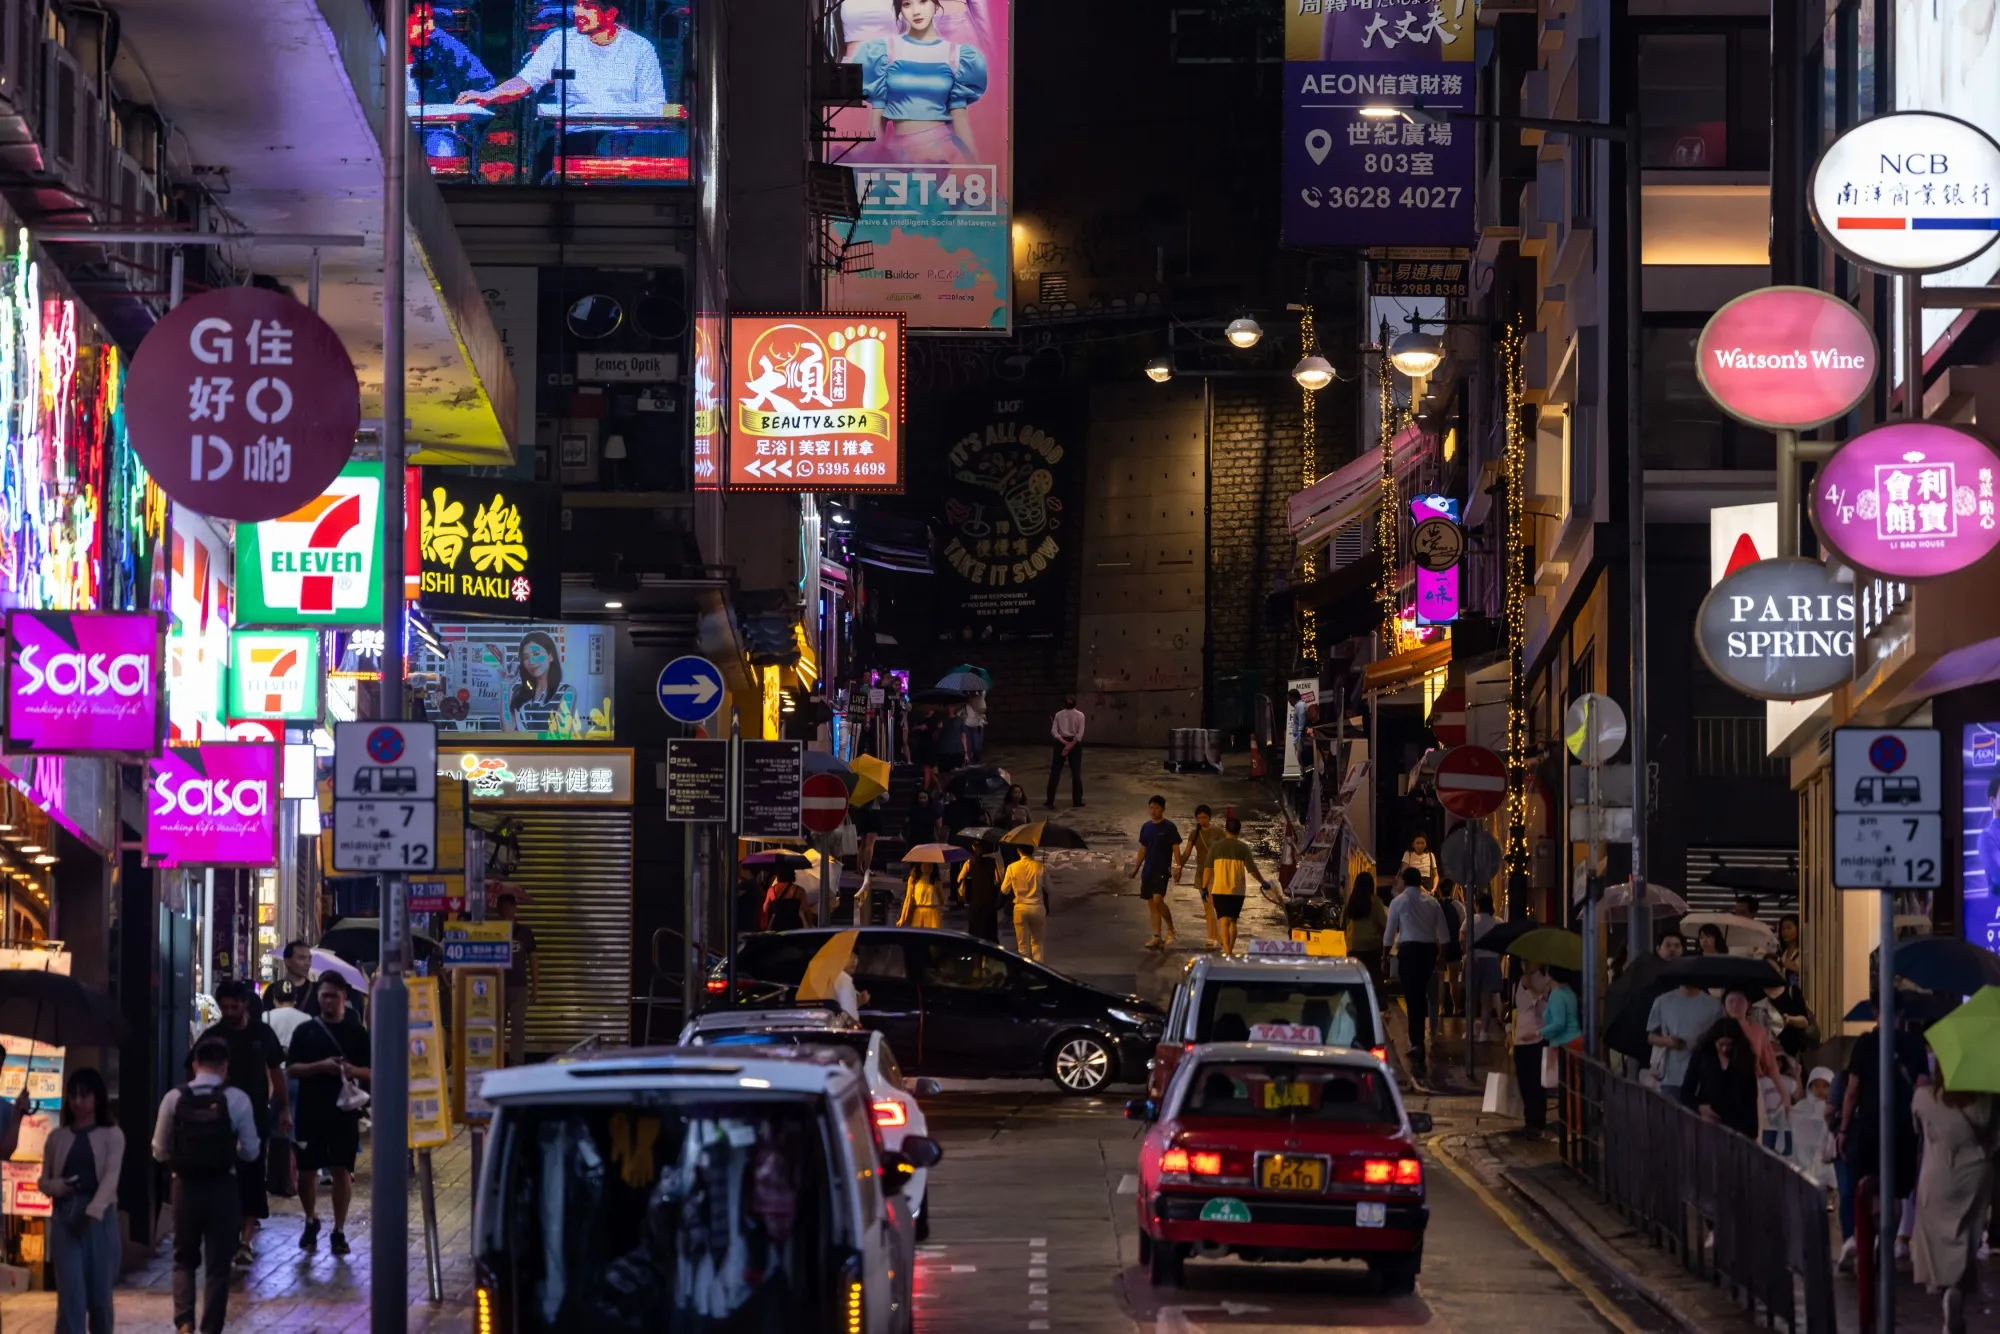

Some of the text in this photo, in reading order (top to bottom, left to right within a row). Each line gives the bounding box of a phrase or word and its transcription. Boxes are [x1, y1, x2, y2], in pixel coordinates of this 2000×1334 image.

[1301, 74, 1463, 95] AEON信貸財務
[1347, 121, 1453, 146] 世紀廣場
[1364, 152, 1434, 176] 803室
[1880, 154, 1949, 174] NCB
[1328, 186, 1462, 208] 3628 4027
[1837, 181, 1990, 206] 南洋商業銀行
[890, 218, 930, 228] Intelligent
[931, 219, 955, 227] Social
[957, 219, 997, 227] Metaverse
[1395, 263, 1463, 281] 易通集團
[1374, 284, 1466, 296] TEL: 2988 8348
[630, 357, 661, 373] Optik
[1714, 348, 1865, 369] Watson's Wine
[985, 422, 1018, 446] ALL
[1019, 424, 1065, 465] GOOD
[817, 462, 886, 476] 5395 4698
[1825, 484, 1855, 524] 4/F
[1918, 540, 1945, 548] HOUSE
[943, 535, 1061, 586] TAKE IT SLOW
[461, 574, 510, 599] RAKU
[1730, 595, 1854, 622] PARIS
[1728, 629, 1854, 658] SPRING
[471, 677, 489, 688] Vita
[478, 687, 499, 699] Hair
[24, 700, 65, 720] making
[66, 700, 89, 720] life
[515, 767, 614, 793] 維特健靈
[399, 805, 415, 828] 7
[159, 819, 194, 837] making
[195, 819, 214, 837] life
[1859, 817, 1920, 842] am 7
[340, 839, 428, 865] midnight 12
[1840, 855, 1935, 882] midnight 12
[411, 884, 425, 896] 12
[446, 944, 464, 959] 40
[1255, 941, 1303, 953] TAXI
[1257, 1025, 1316, 1041] TAXI
[1279, 1160, 1304, 1175] PZ
[1269, 1173, 1314, 1190] 6410
[1220, 1204, 1231, 1214] 4
